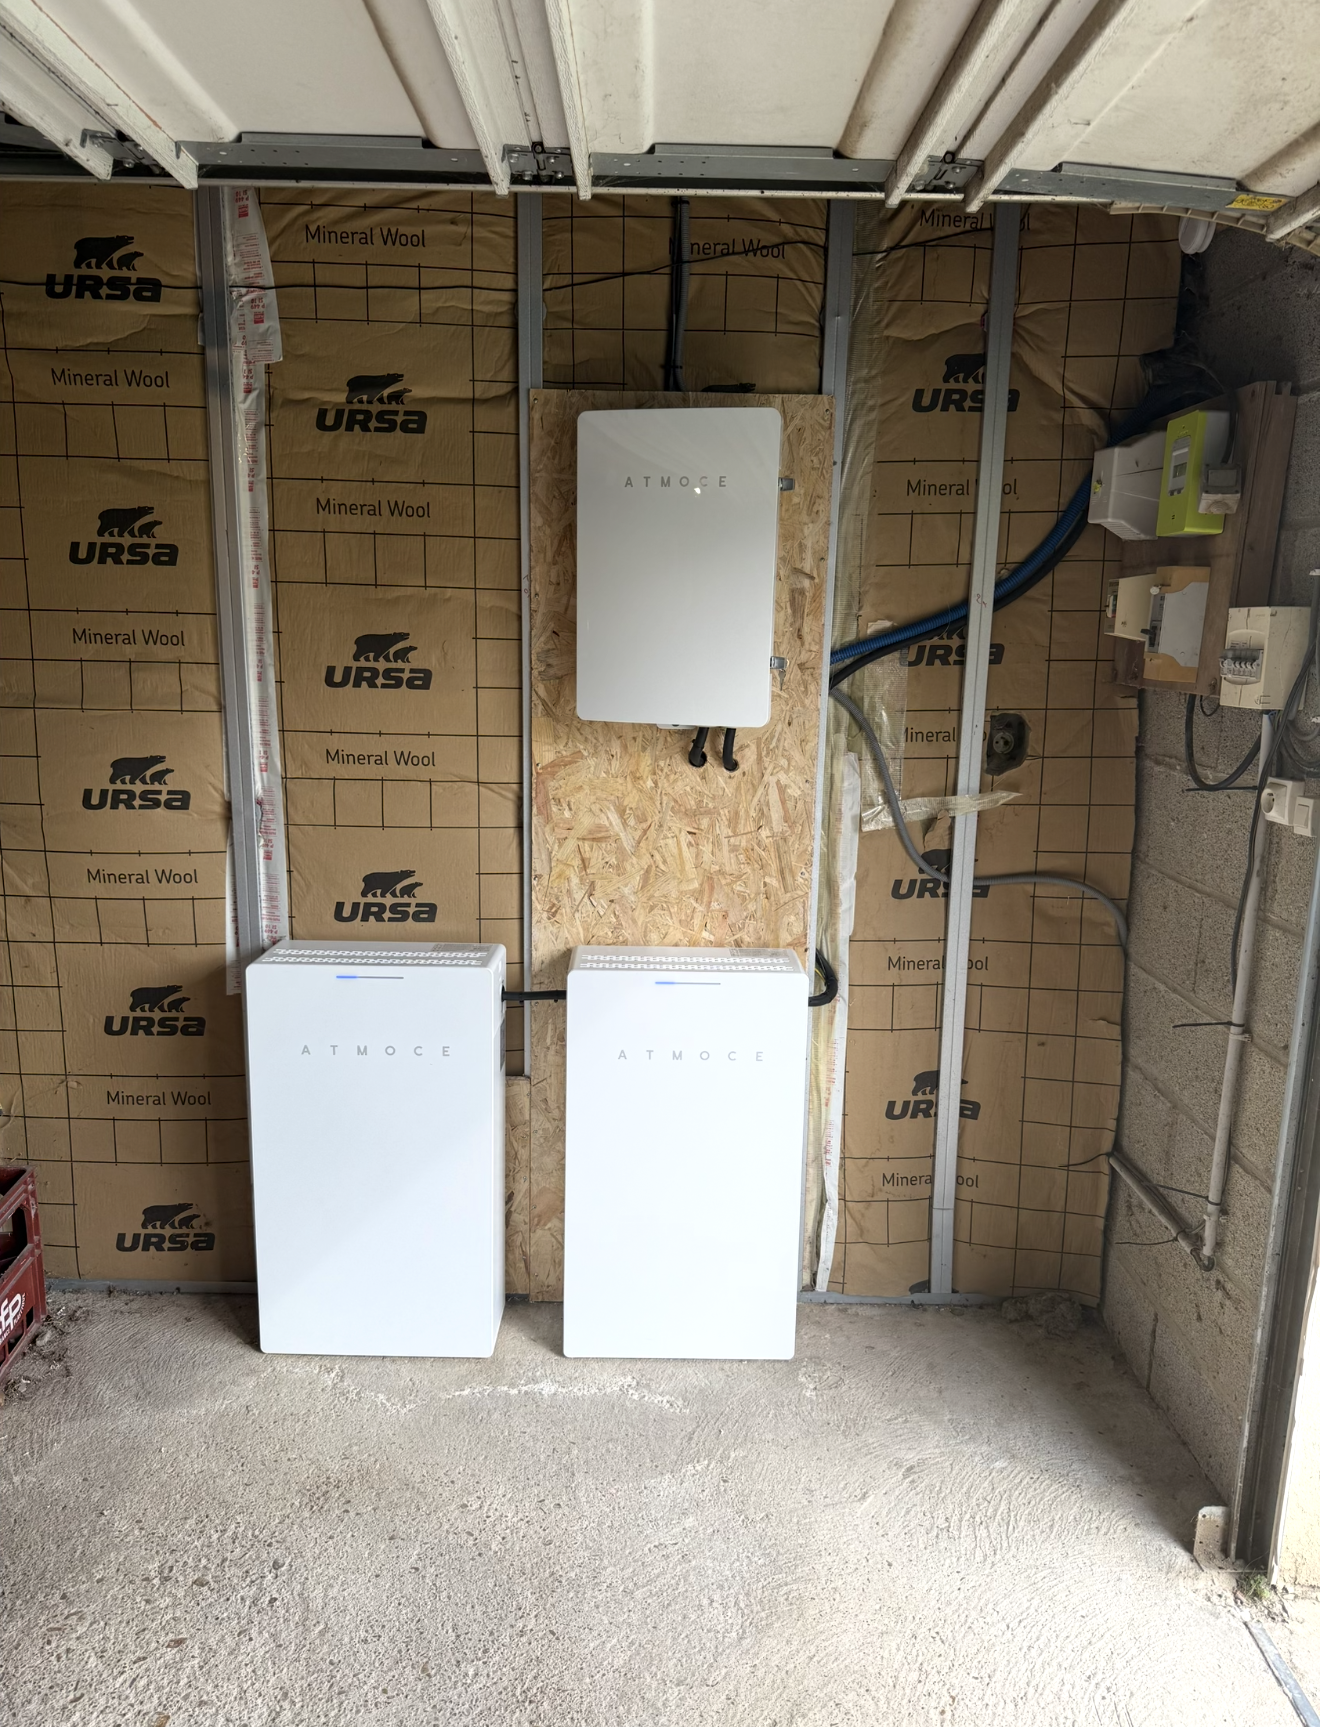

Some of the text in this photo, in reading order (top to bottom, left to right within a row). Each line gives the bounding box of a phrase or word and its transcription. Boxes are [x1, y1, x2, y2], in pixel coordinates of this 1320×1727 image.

[920, 208, 984, 230] Mineral
[304, 224, 425, 247] Mineral Wool
[669, 237, 785, 260] neral Wool
[51, 368, 170, 388] Mineral Wool
[625, 475, 727, 488] ATMOCE
[906, 479, 970, 496] Mineral
[316, 498, 431, 518] Mineral Wool
[73, 628, 185, 647] Mineral Wool
[325, 748, 436, 767] Mineral Wool
[87, 868, 198, 885] Mineral Wool
[300, 1044, 451, 1058] ATMOCE
[617, 1049, 764, 1062] ATMOCE
[106, 1090, 212, 1106] Mineral Wool
